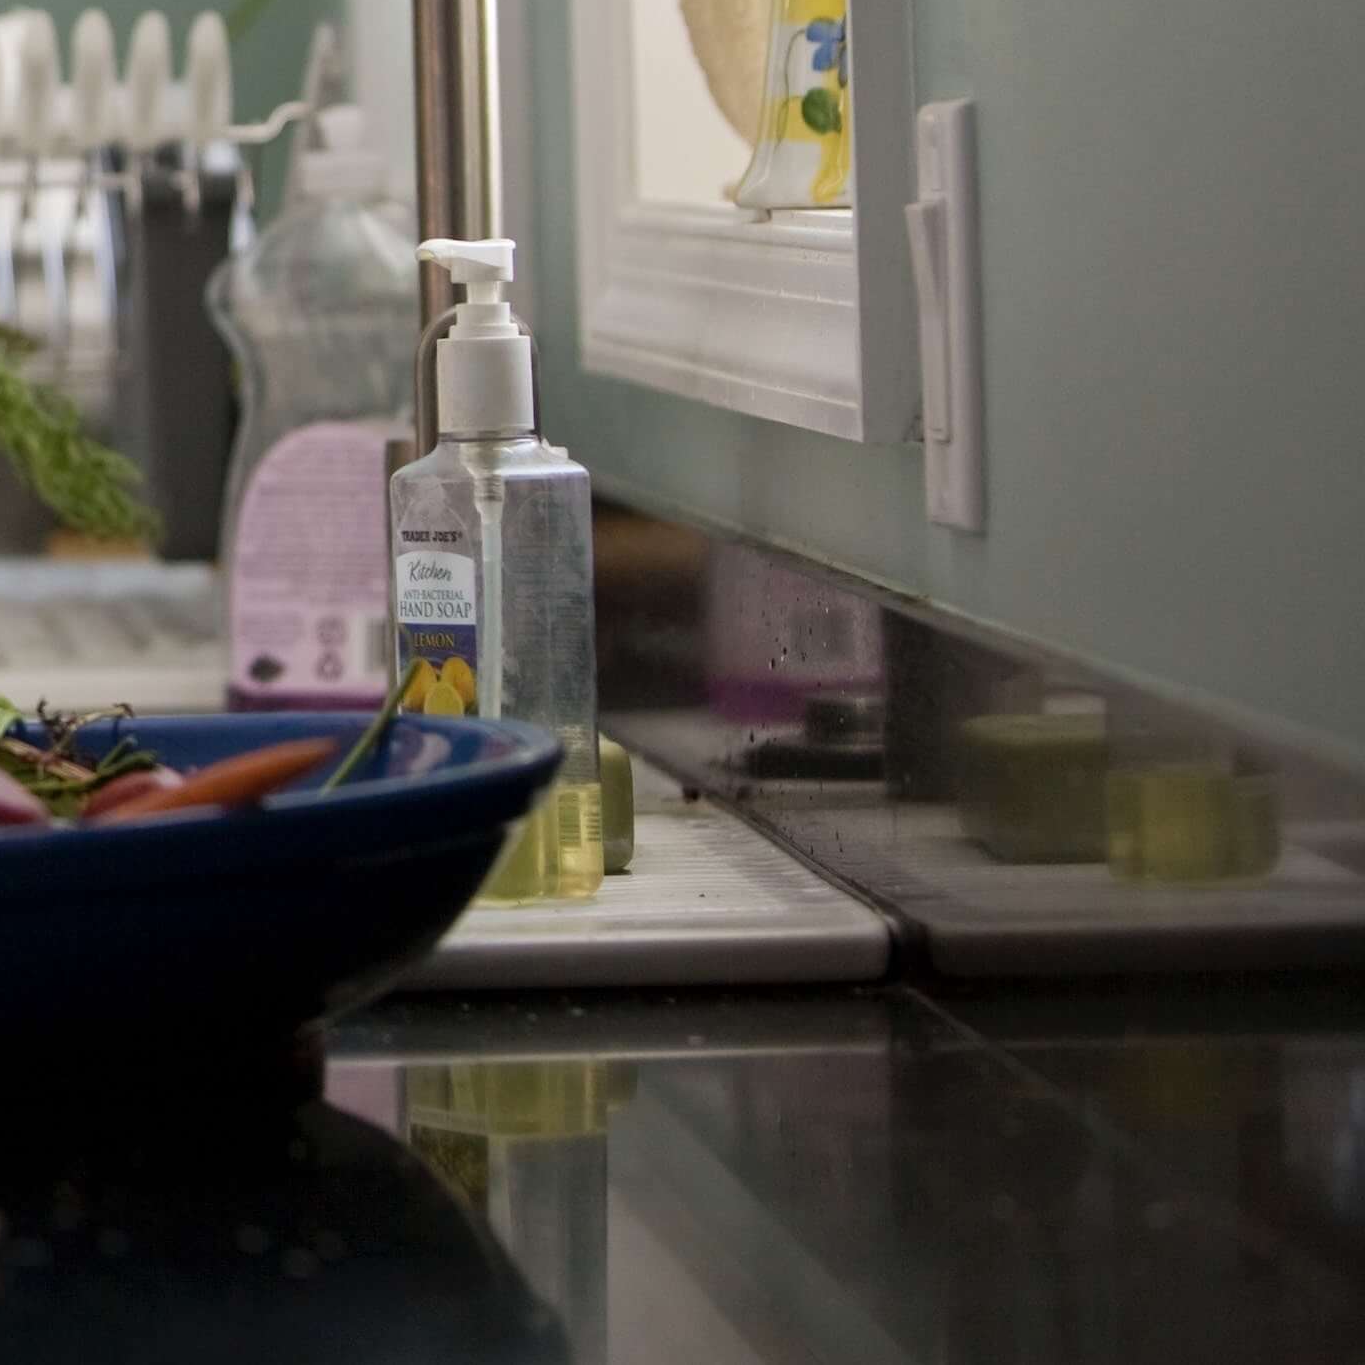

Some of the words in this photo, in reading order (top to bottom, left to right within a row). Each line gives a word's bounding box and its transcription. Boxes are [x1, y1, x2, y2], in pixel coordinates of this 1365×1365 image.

[401, 530, 430, 542] TRADER
[408, 560, 453, 582] Kitchen
[404, 590, 465, 601] ANTI-BACTERIAL
[400, 601, 434, 618] HAND
[437, 601, 472, 619] SOAP
[413, 632, 454, 648] LEMON
